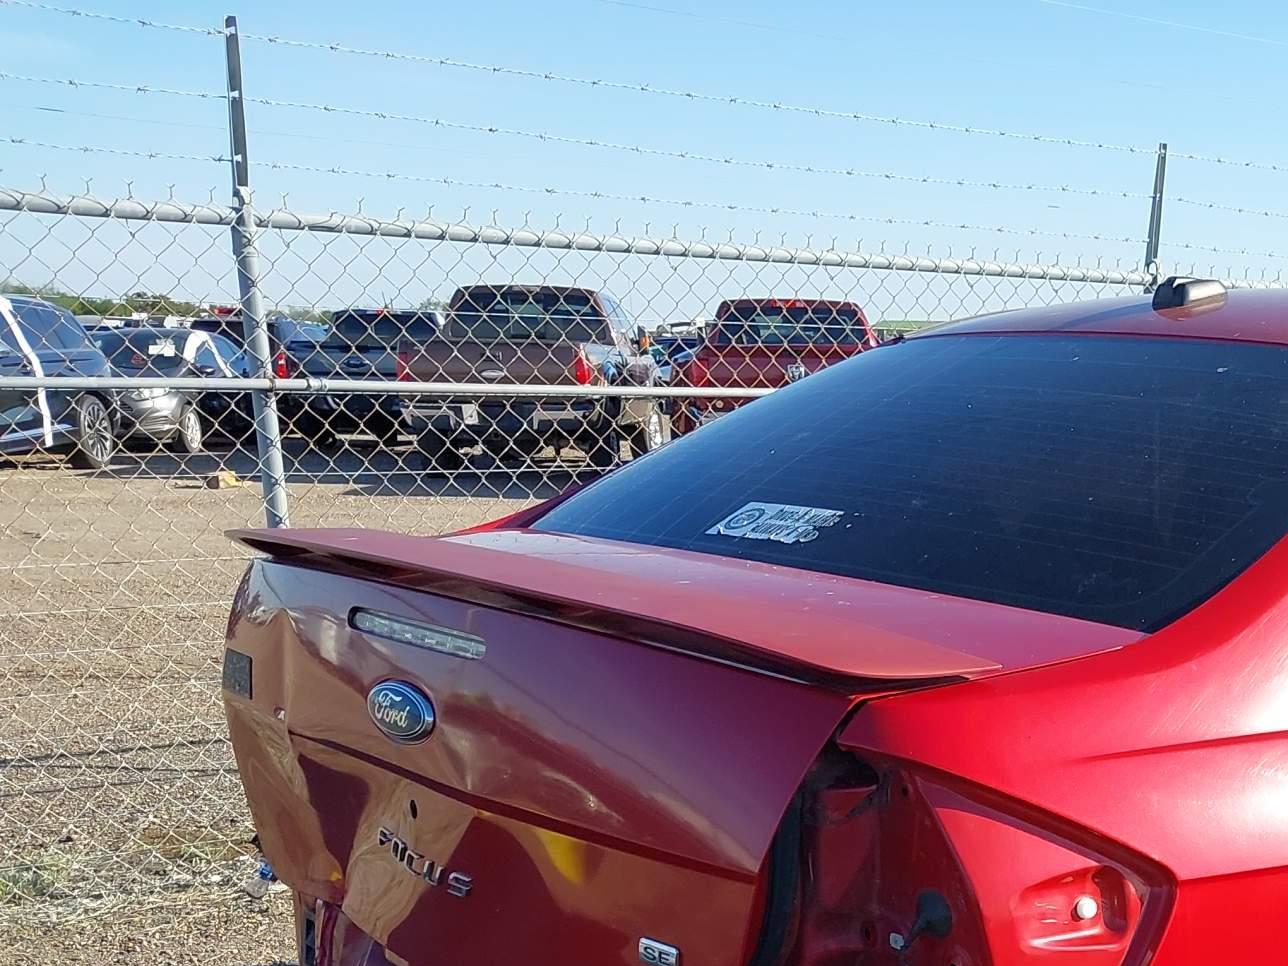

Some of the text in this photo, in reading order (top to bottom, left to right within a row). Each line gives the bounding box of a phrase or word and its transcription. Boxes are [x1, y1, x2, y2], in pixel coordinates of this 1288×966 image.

[374, 690, 410, 728] Ford
[378, 827, 472, 897] FOCUS
[642, 946, 672, 966] SE
